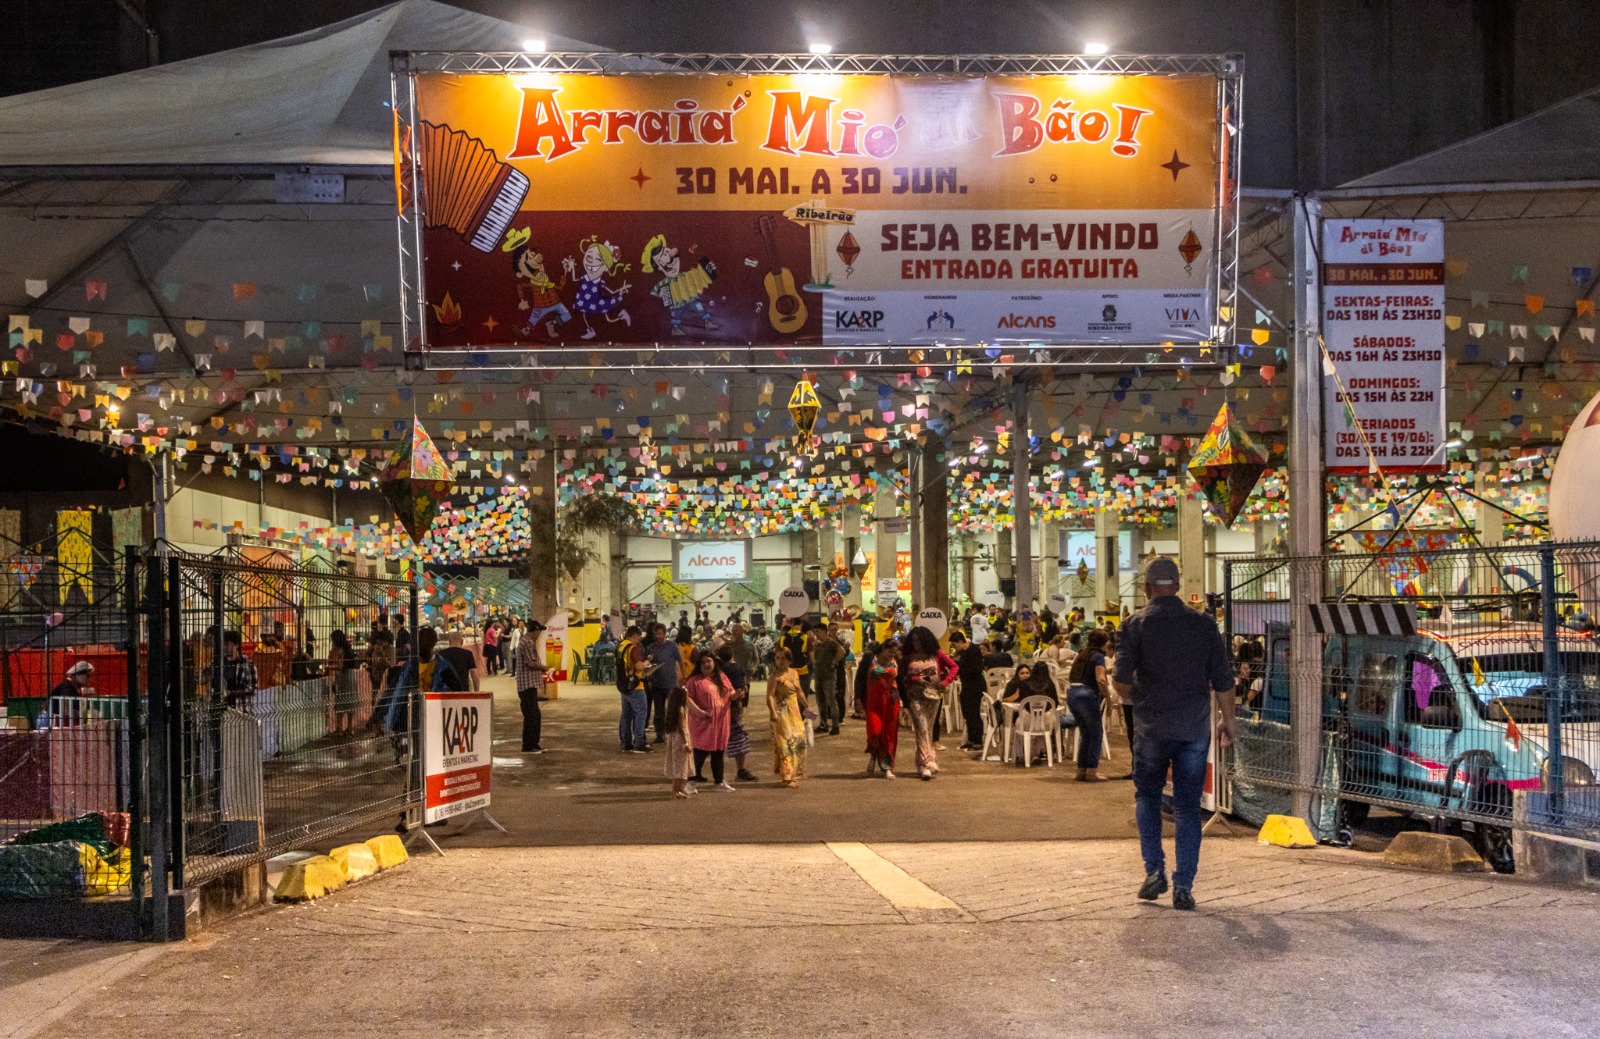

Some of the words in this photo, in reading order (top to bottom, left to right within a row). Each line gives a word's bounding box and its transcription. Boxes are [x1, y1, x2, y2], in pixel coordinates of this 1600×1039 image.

[506, 84, 747, 162] Arraiá
[761, 89, 909, 159] Mió
[991, 91, 1154, 158] Bão!
[676, 167, 717, 195] 30
[729, 167, 800, 195] MAI.
[811, 167, 831, 195] A
[841, 167, 881, 194] 30
[892, 167, 968, 194] JUN.
[796, 208, 853, 222] Ribeirão
[881, 223, 959, 251] SEJA
[971, 222, 1159, 251] BEM-VINDO
[901, 259, 1013, 280] ENTRADA
[1021, 258, 1138, 279] GRATUITA
[1328, 269, 1346, 280] 30
[1350, 269, 1378, 280] MAI.
[1388, 269, 1405, 280] 30
[1408, 269, 1438, 280] JUN.
[1334, 296, 1433, 308] SEXTAS-FEIRAS:
[1164, 308, 1200, 320] VIVA
[1327, 310, 1351, 320] DAS
[1355, 310, 1378, 320] 18H
[1382, 307, 1398, 320] ÀS
[1402, 309, 1442, 320] 23H30
[1353, 335, 1416, 348] SÁBADOS:
[1328, 350, 1352, 362] DAS
[1356, 350, 1378, 362] 16H
[1382, 348, 1398, 362] ÀS
[1402, 350, 1442, 362] 23H30
[1349, 378, 1420, 390] DOMINGOS:
[1336, 392, 1360, 402] DAS
[1364, 392, 1386, 402] 15H
[1390, 390, 1406, 402] ÀS
[1410, 391, 1434, 402] 22H
[1381, 432, 1388, 444] E
[1391, 430, 1434, 444] 19/06):
[1336, 446, 1360, 457] DAS
[1391, 444, 1406, 457] ÀS
[1410, 446, 1434, 456] 22H
[442, 756, 458, 768] EVENTOS
